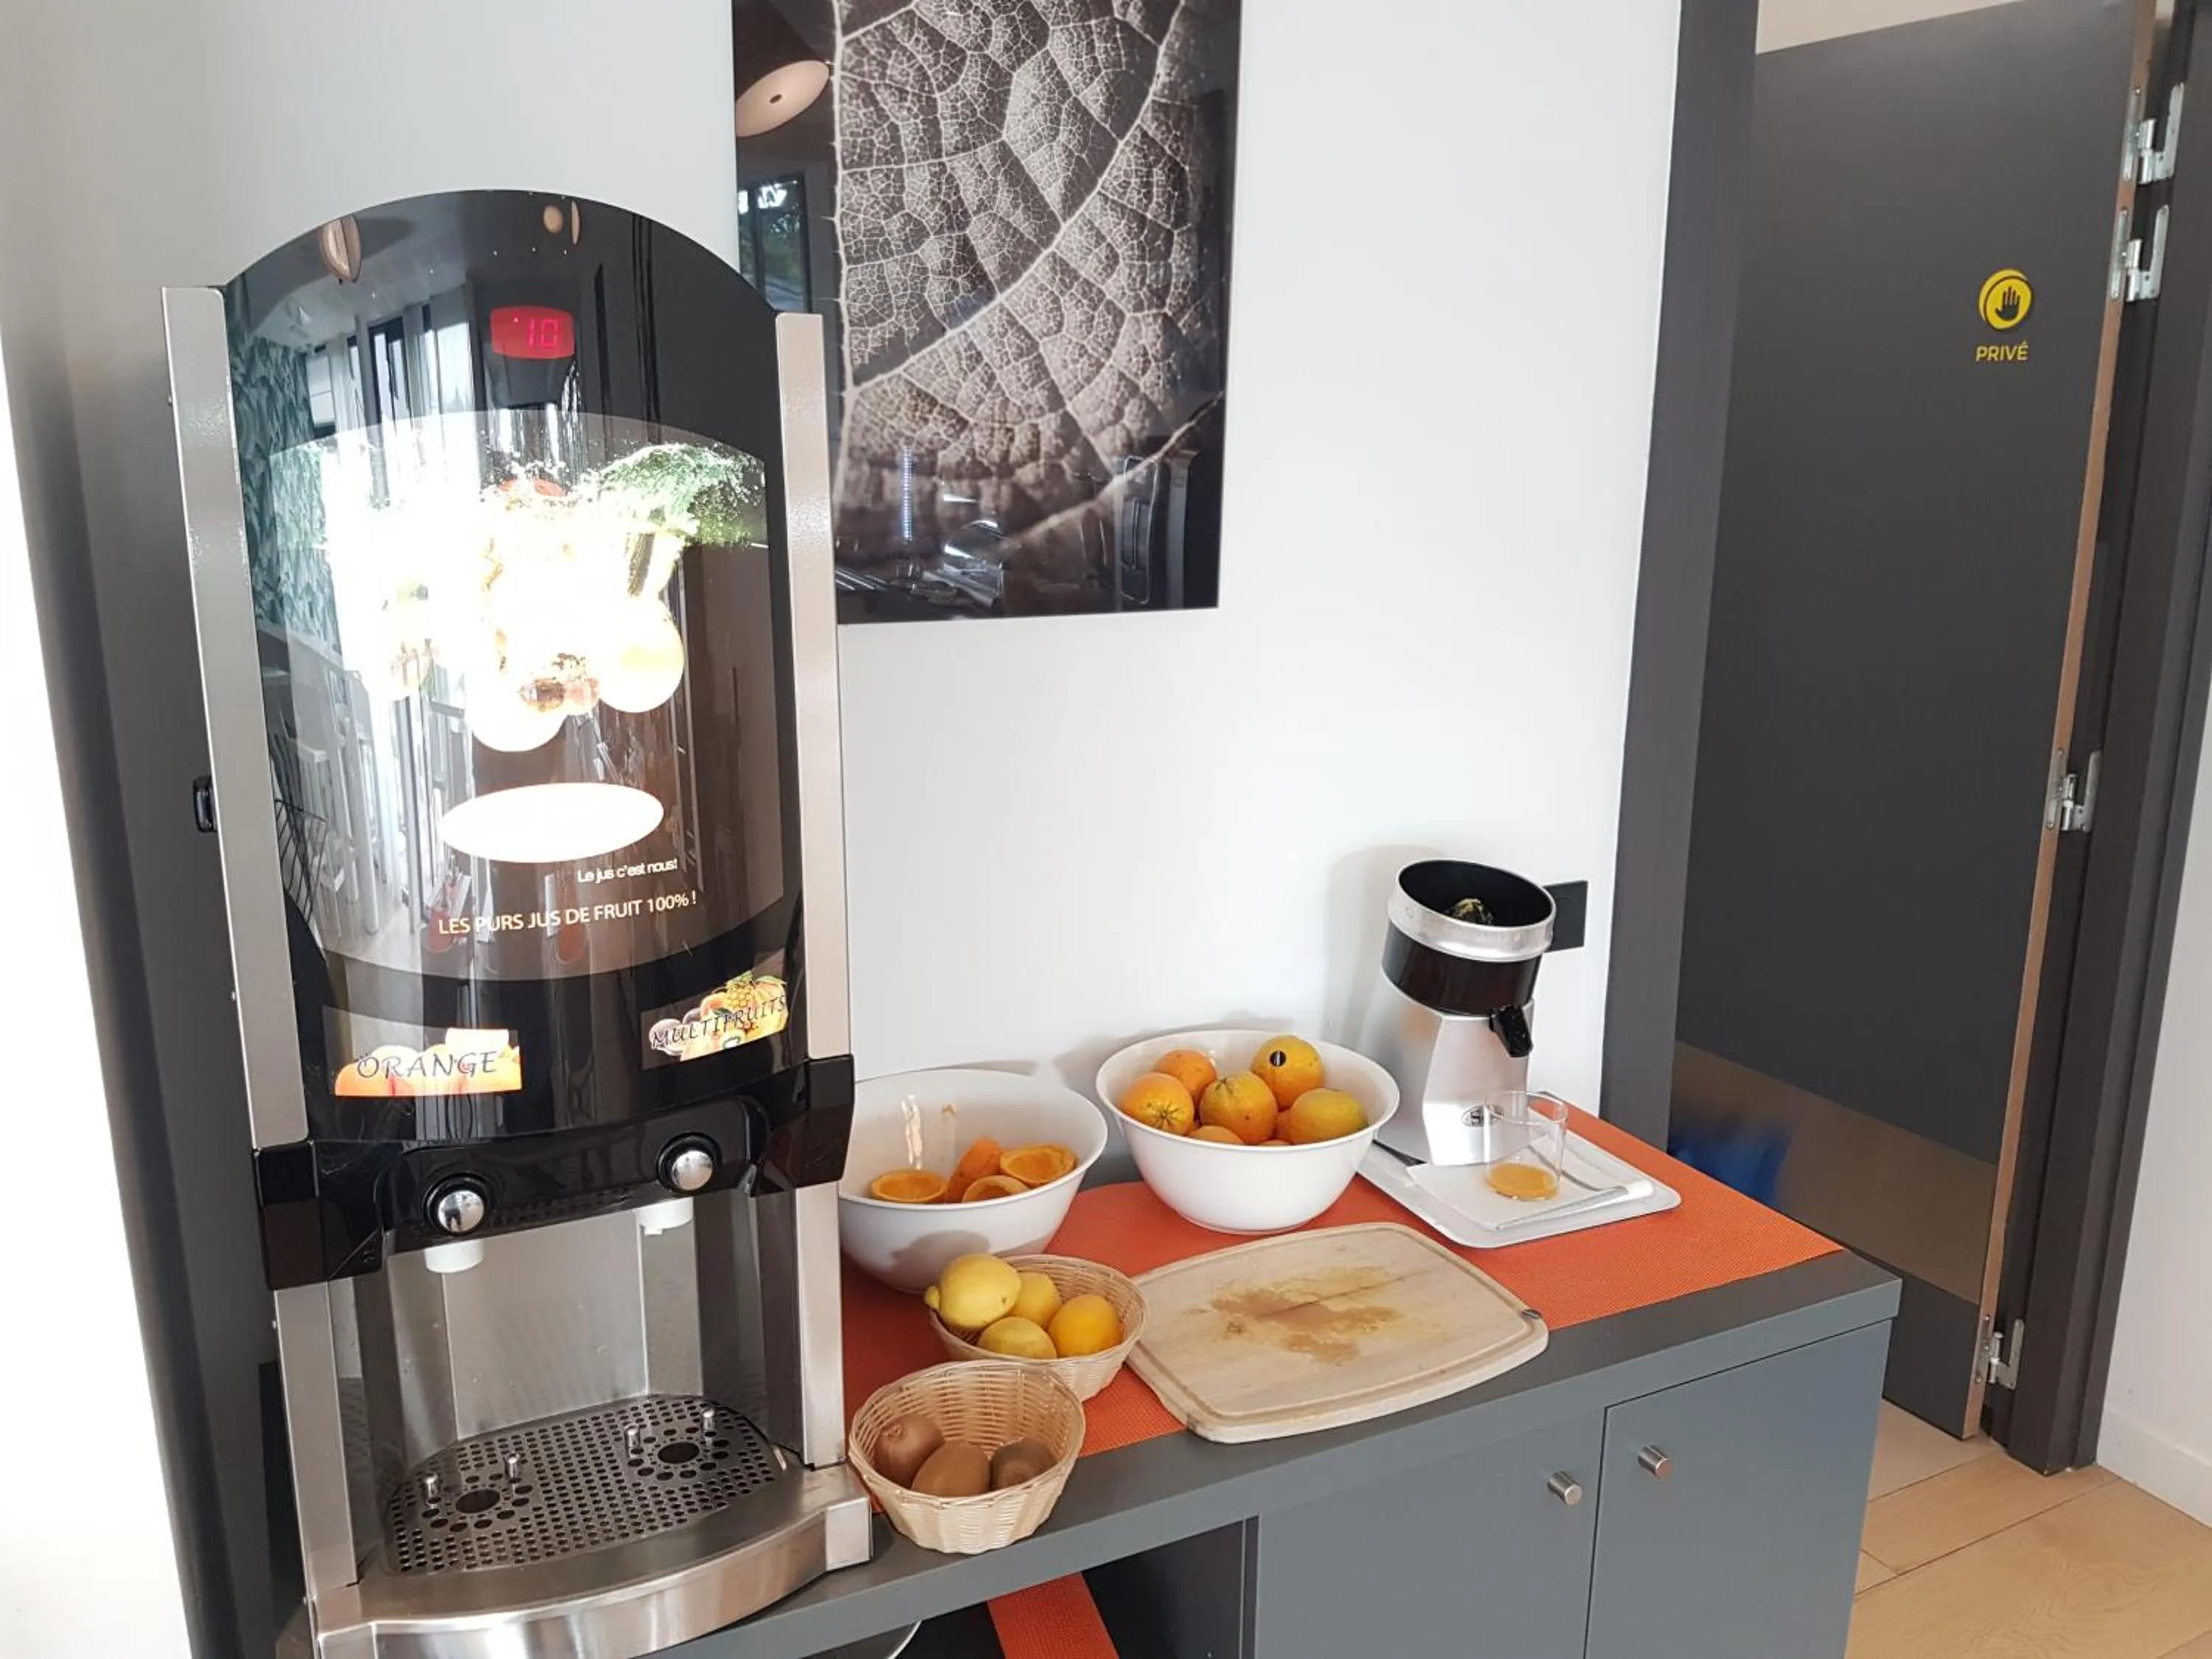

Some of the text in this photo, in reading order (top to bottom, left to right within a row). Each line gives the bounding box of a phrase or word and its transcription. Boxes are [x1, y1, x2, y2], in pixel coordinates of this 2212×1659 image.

[1975, 341, 2029, 361] PRIVÉ
[577, 869, 594, 883] Le
[595, 868, 614, 884] jus
[439, 917, 471, 935] LES
[474, 914, 524, 933] PURS
[527, 910, 561, 929] JUS
[566, 907, 591, 925] DE
[594, 899, 644, 922] FRUIT
[647, 892, 689, 914] 100%
[356, 1051, 498, 1079] ORANGE
